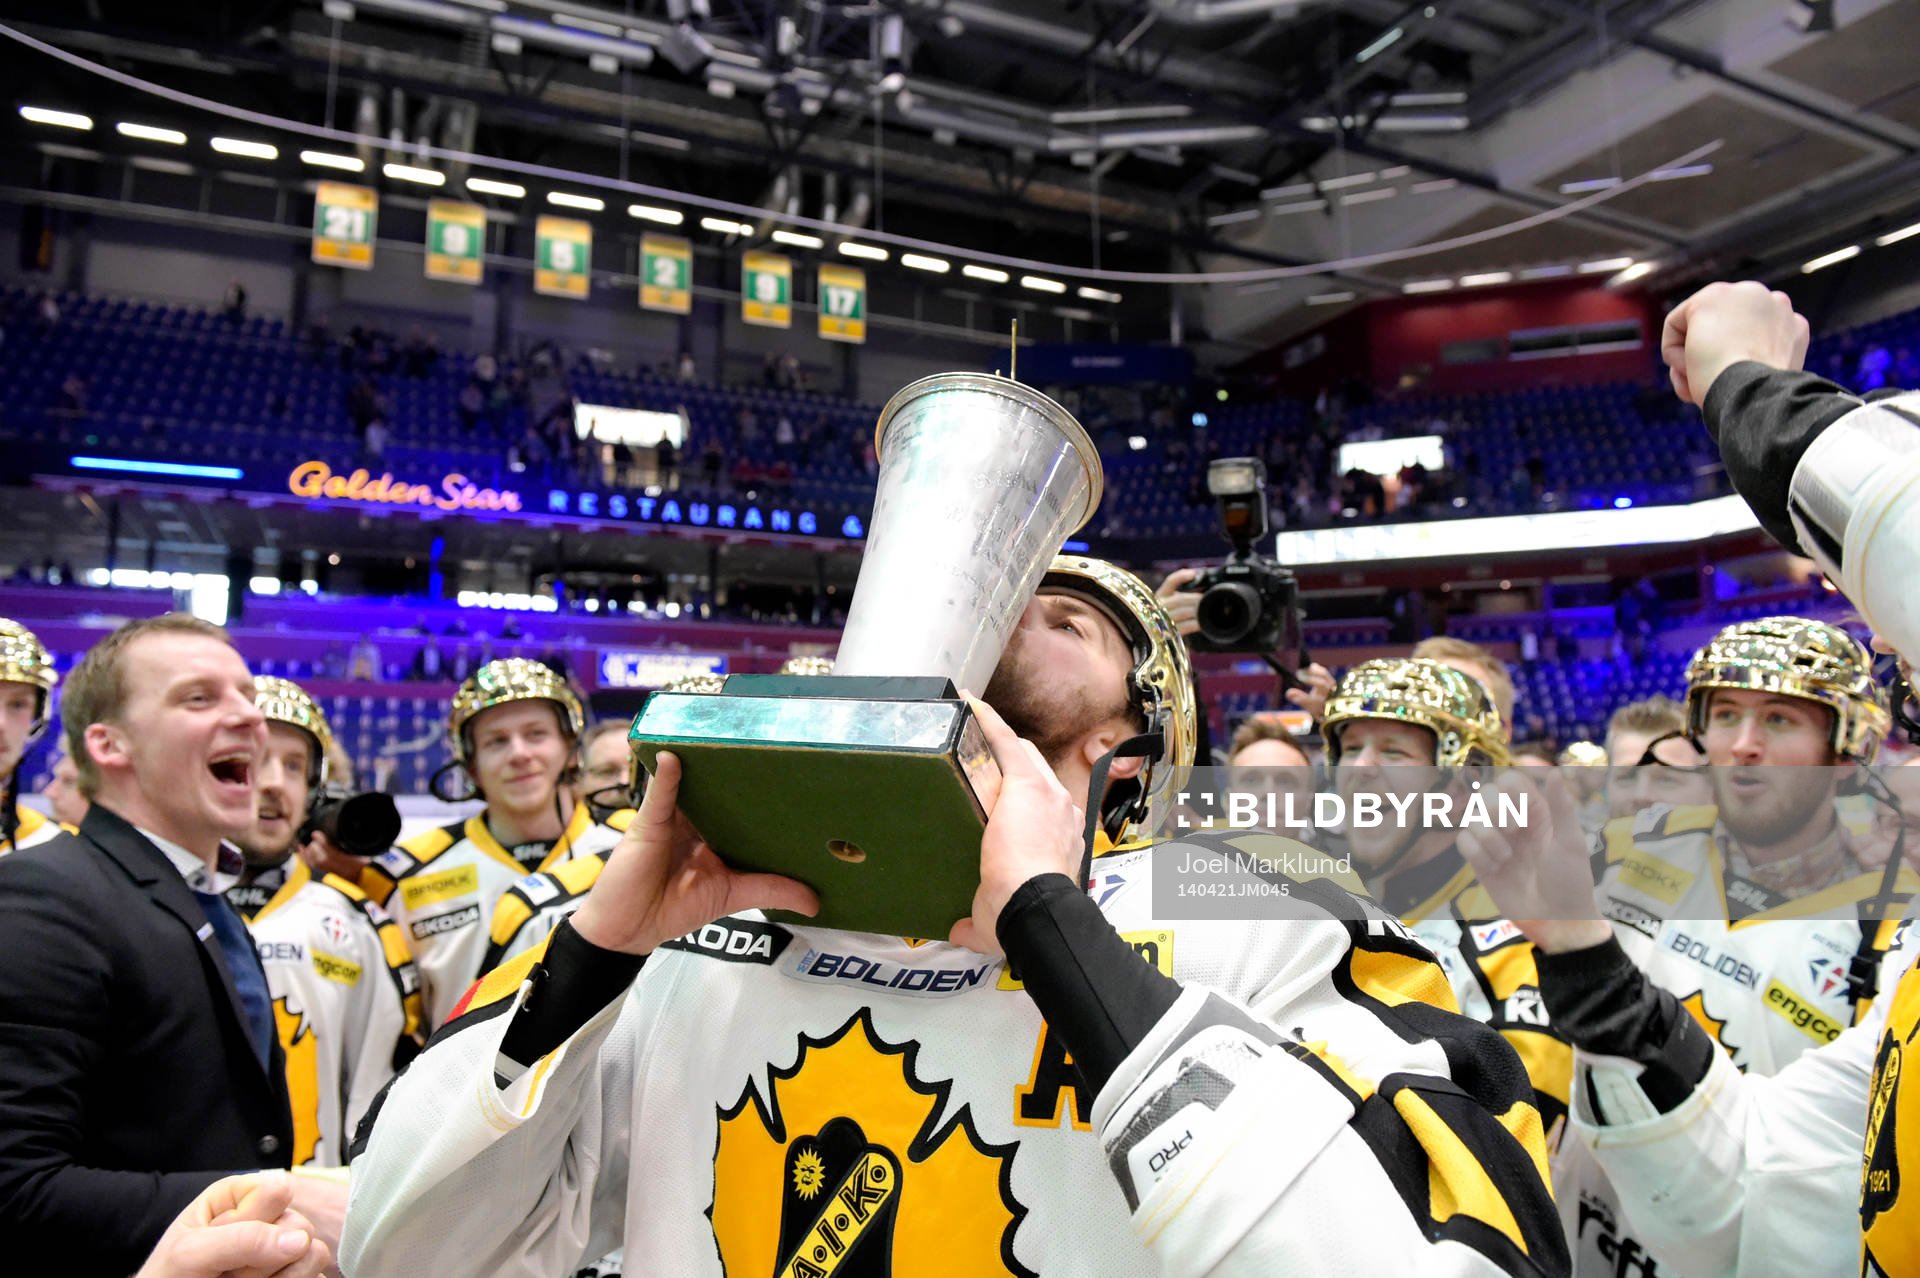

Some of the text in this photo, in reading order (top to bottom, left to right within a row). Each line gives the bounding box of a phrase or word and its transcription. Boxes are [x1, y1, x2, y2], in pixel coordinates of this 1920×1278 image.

[324, 206, 366, 242] 21
[653, 256, 678, 287] 2
[754, 273, 779, 303] 9
[827, 286, 857, 316] 17
[288, 460, 435, 506] Golden
[434, 472, 523, 512] Star
[548, 489, 817, 534] RESTAURANG
[808, 952, 990, 992] BOLIDEN
[1671, 933, 1762, 992] BOLIDEN
[1768, 987, 1841, 1042] engco
[1149, 1130, 1193, 1173] PRO
[1869, 1170, 1891, 1193] 1921
